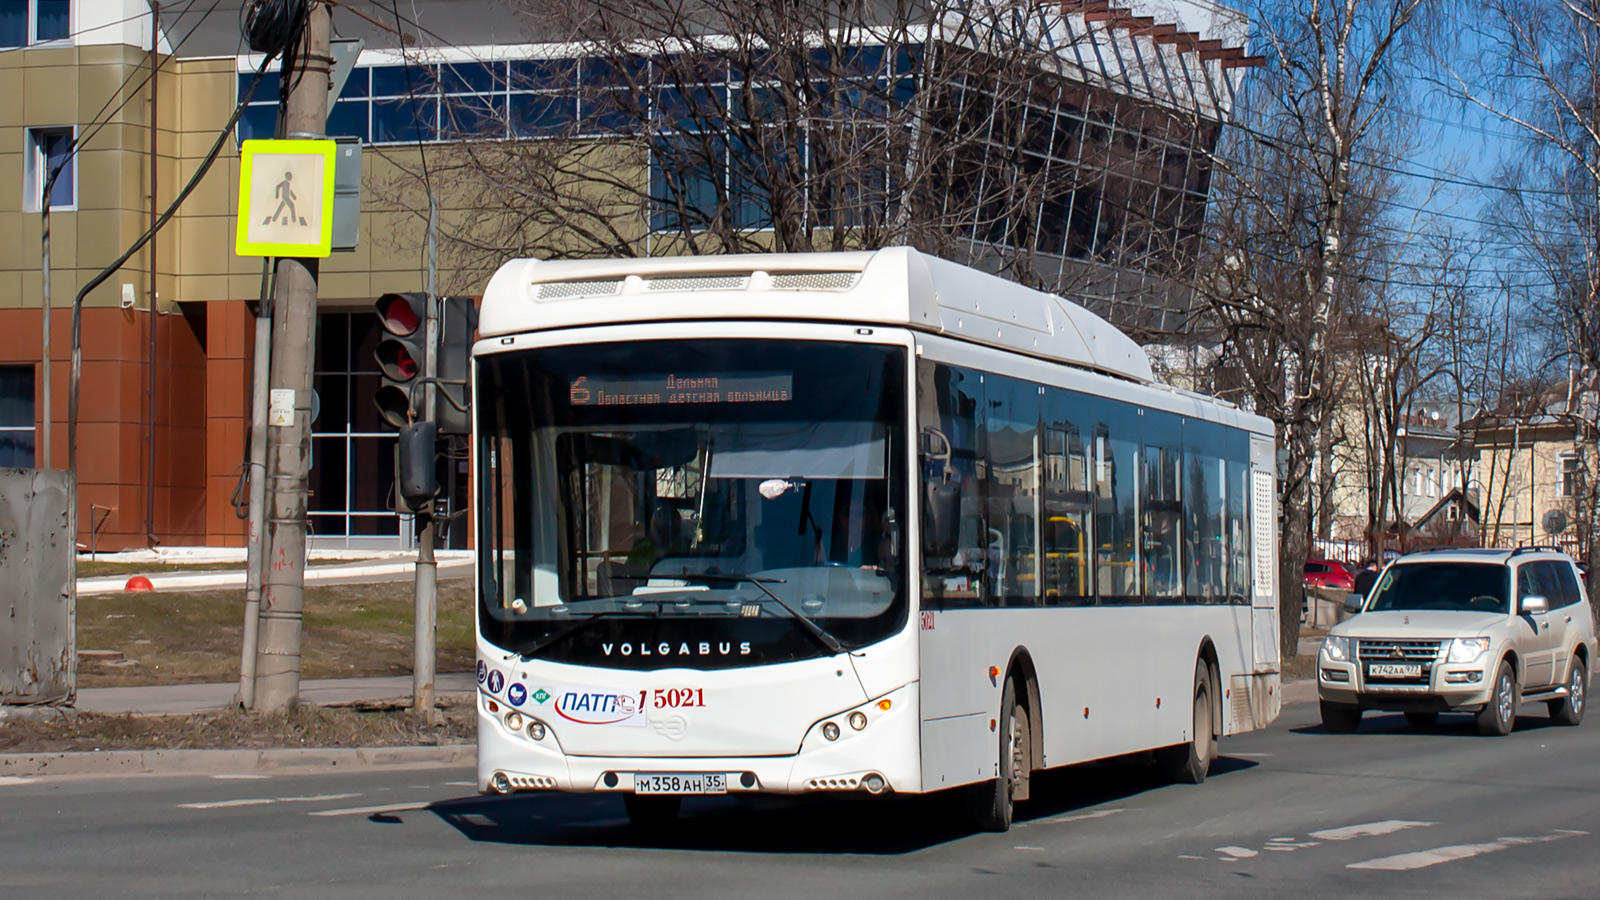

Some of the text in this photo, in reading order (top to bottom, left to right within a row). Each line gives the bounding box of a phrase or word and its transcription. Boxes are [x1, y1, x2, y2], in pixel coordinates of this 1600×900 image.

[666, 374, 718, 389] Дальняя
[570, 376, 590, 404] 6
[669, 392, 720, 403] детская
[602, 642, 751, 656] VOLGABUS
[654, 688, 706, 708] 5021
[705, 776, 721, 787] 35
